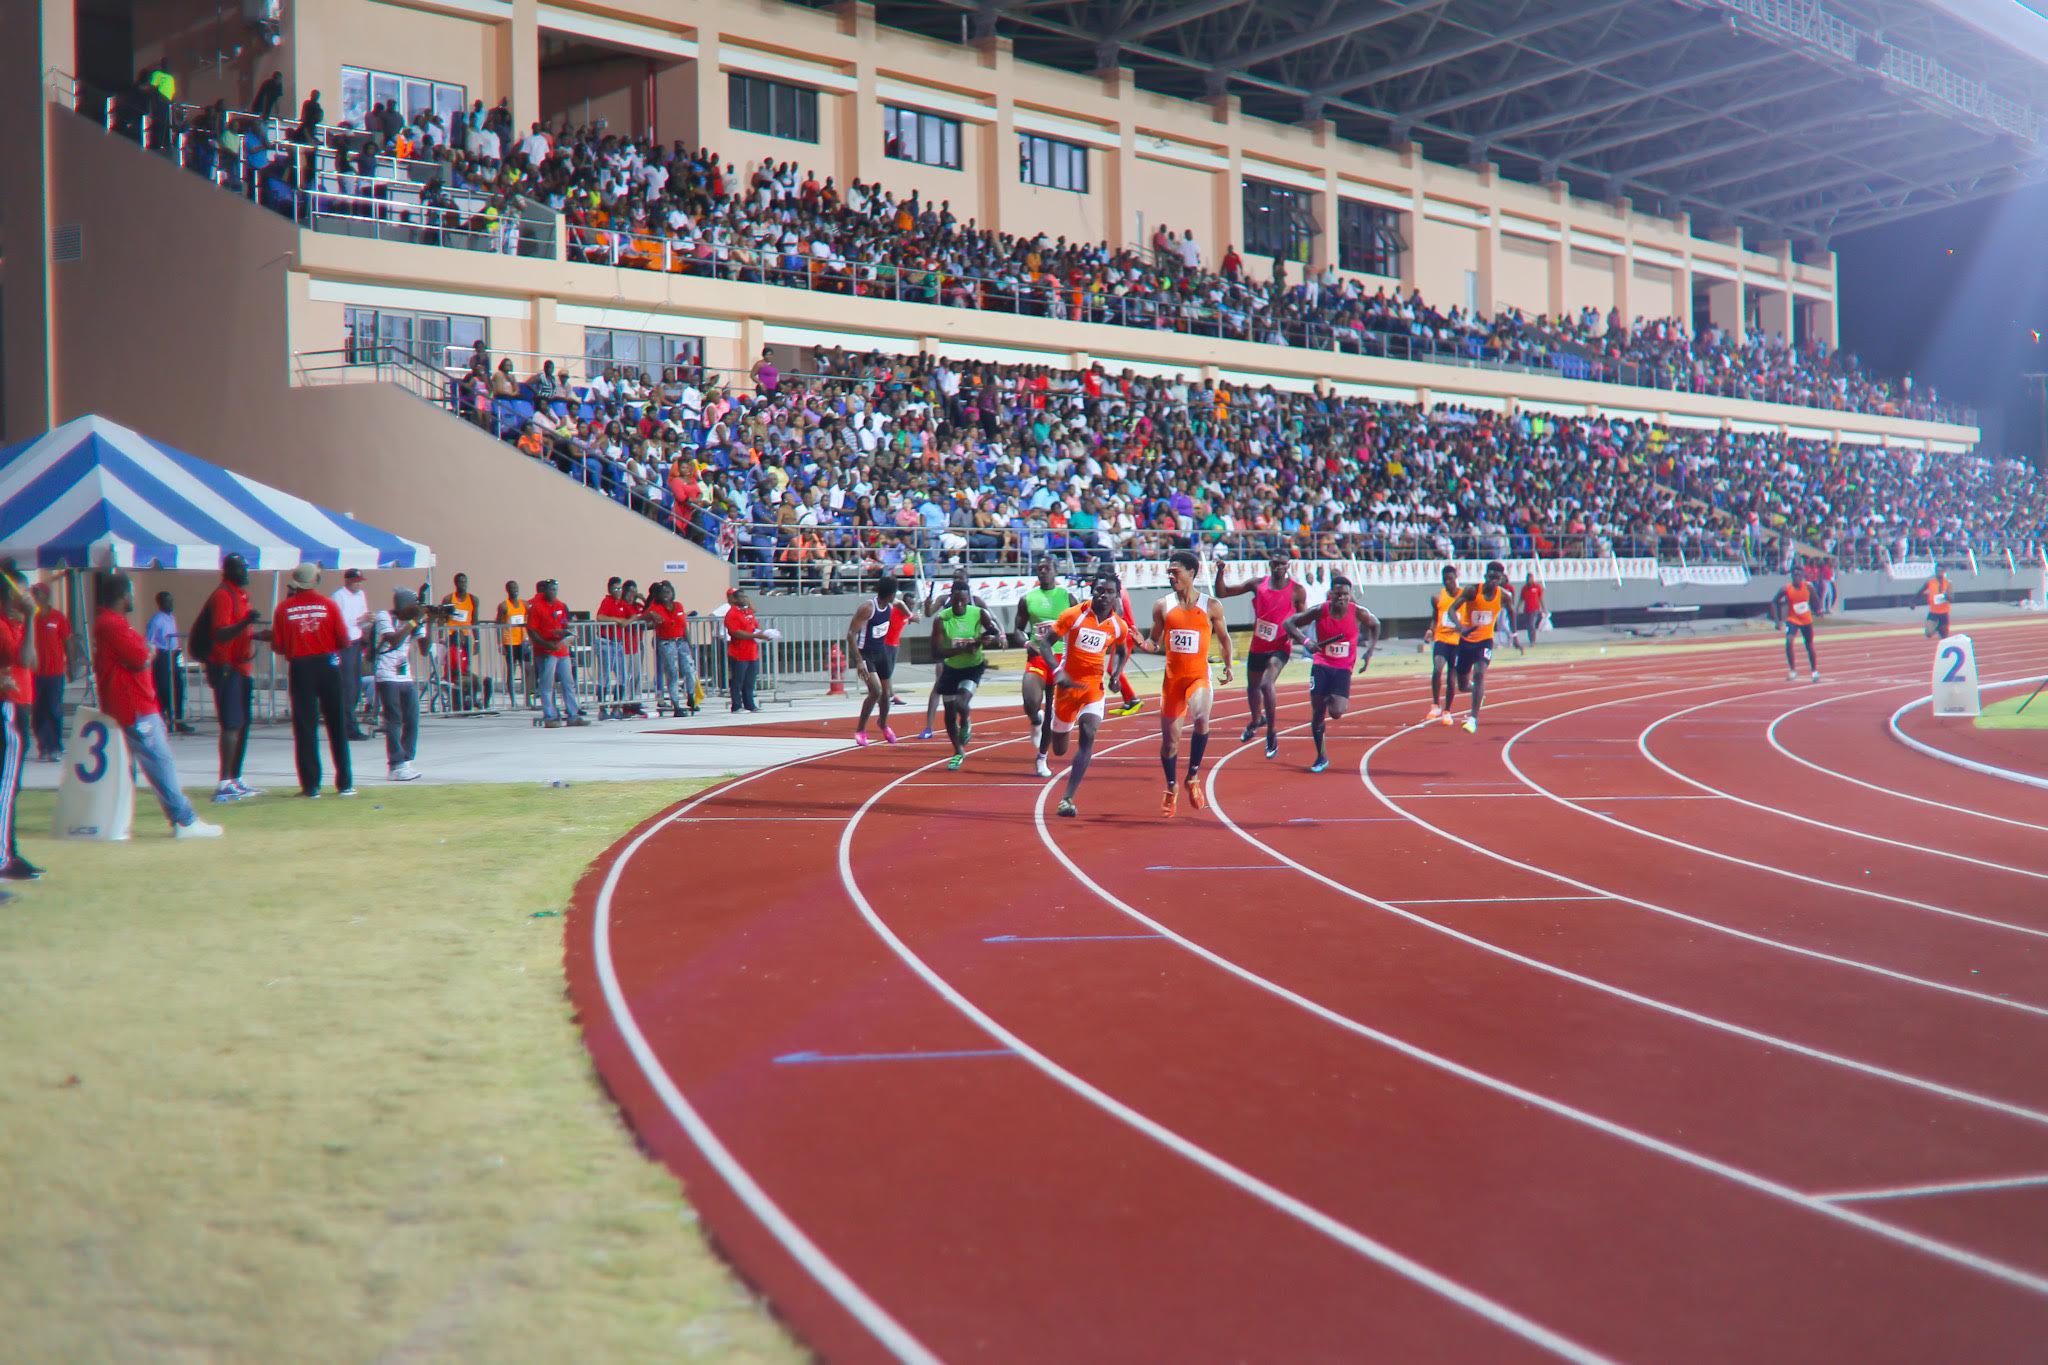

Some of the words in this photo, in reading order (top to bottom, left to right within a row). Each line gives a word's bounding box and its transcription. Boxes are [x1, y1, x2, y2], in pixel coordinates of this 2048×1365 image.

[287, 604, 327, 613] NATIONAL
[1081, 634, 1100, 647] 243
[1174, 635, 1192, 647] 241
[1941, 646, 1966, 682] 2
[74, 721, 109, 783] 3
[68, 826, 98, 835] UCS
